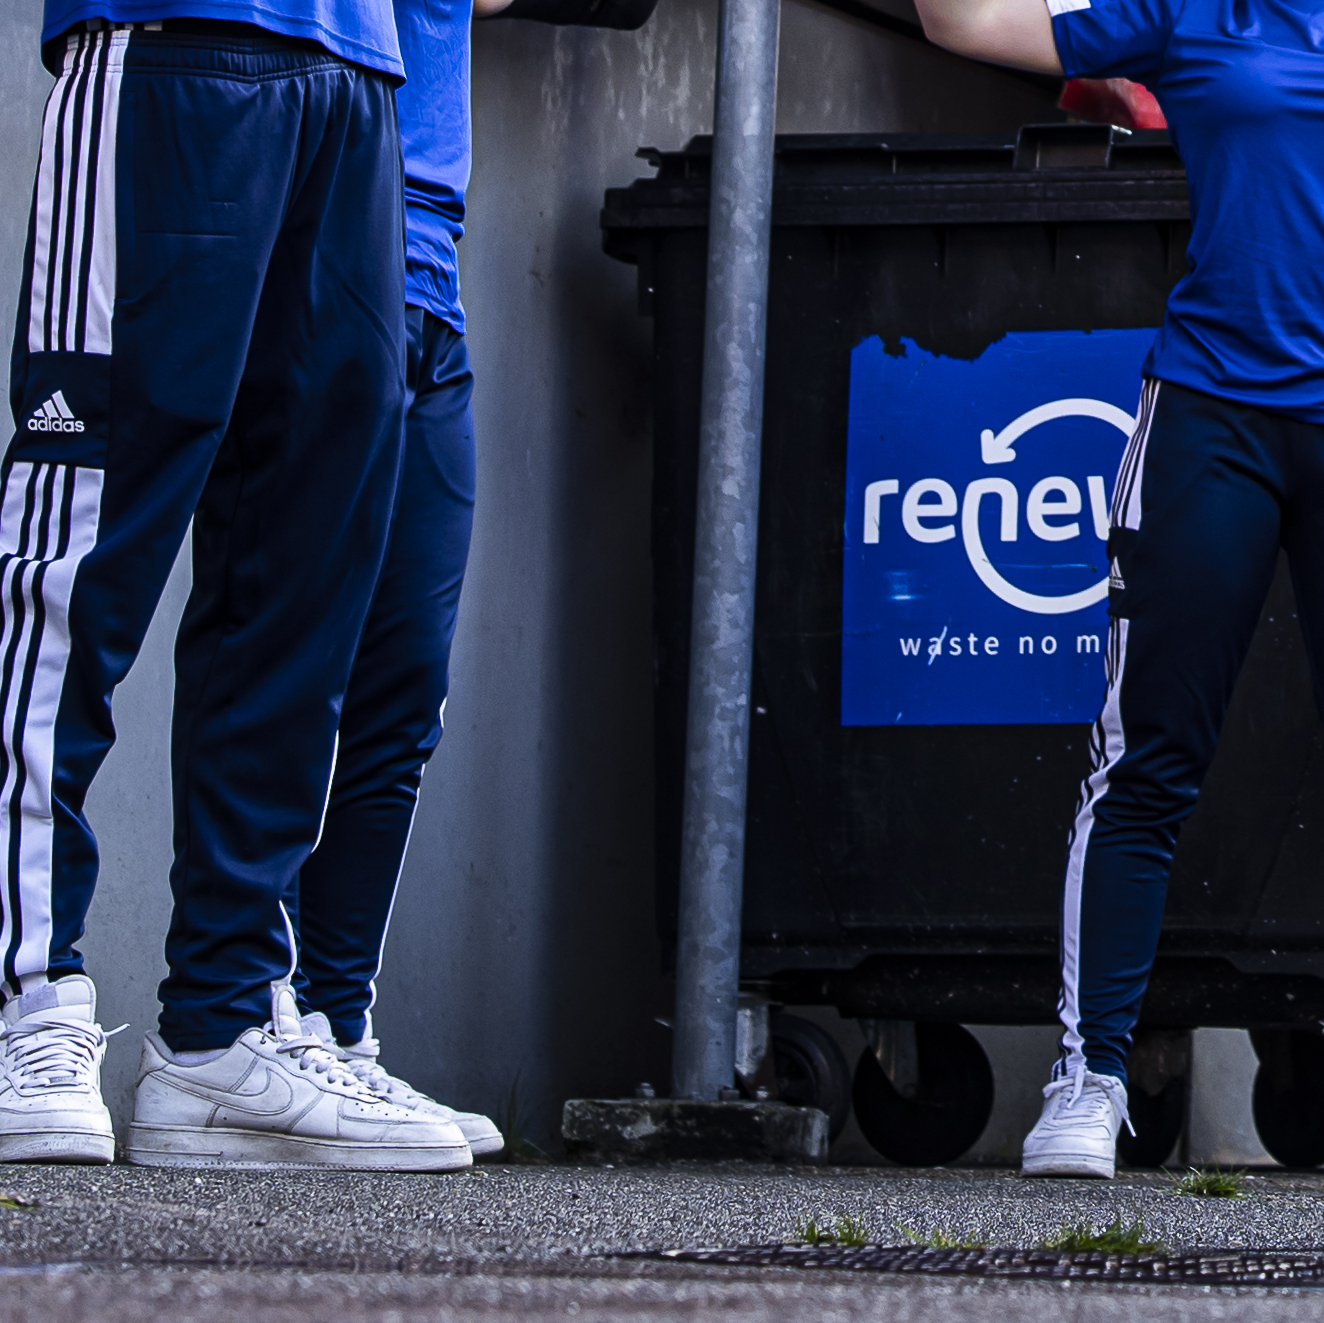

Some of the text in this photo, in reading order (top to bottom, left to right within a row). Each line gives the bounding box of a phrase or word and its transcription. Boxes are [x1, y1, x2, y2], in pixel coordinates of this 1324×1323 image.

[27, 416, 86, 433] adidas
[863, 475, 1110, 544] rene
[899, 633, 1101, 657] waste no m
